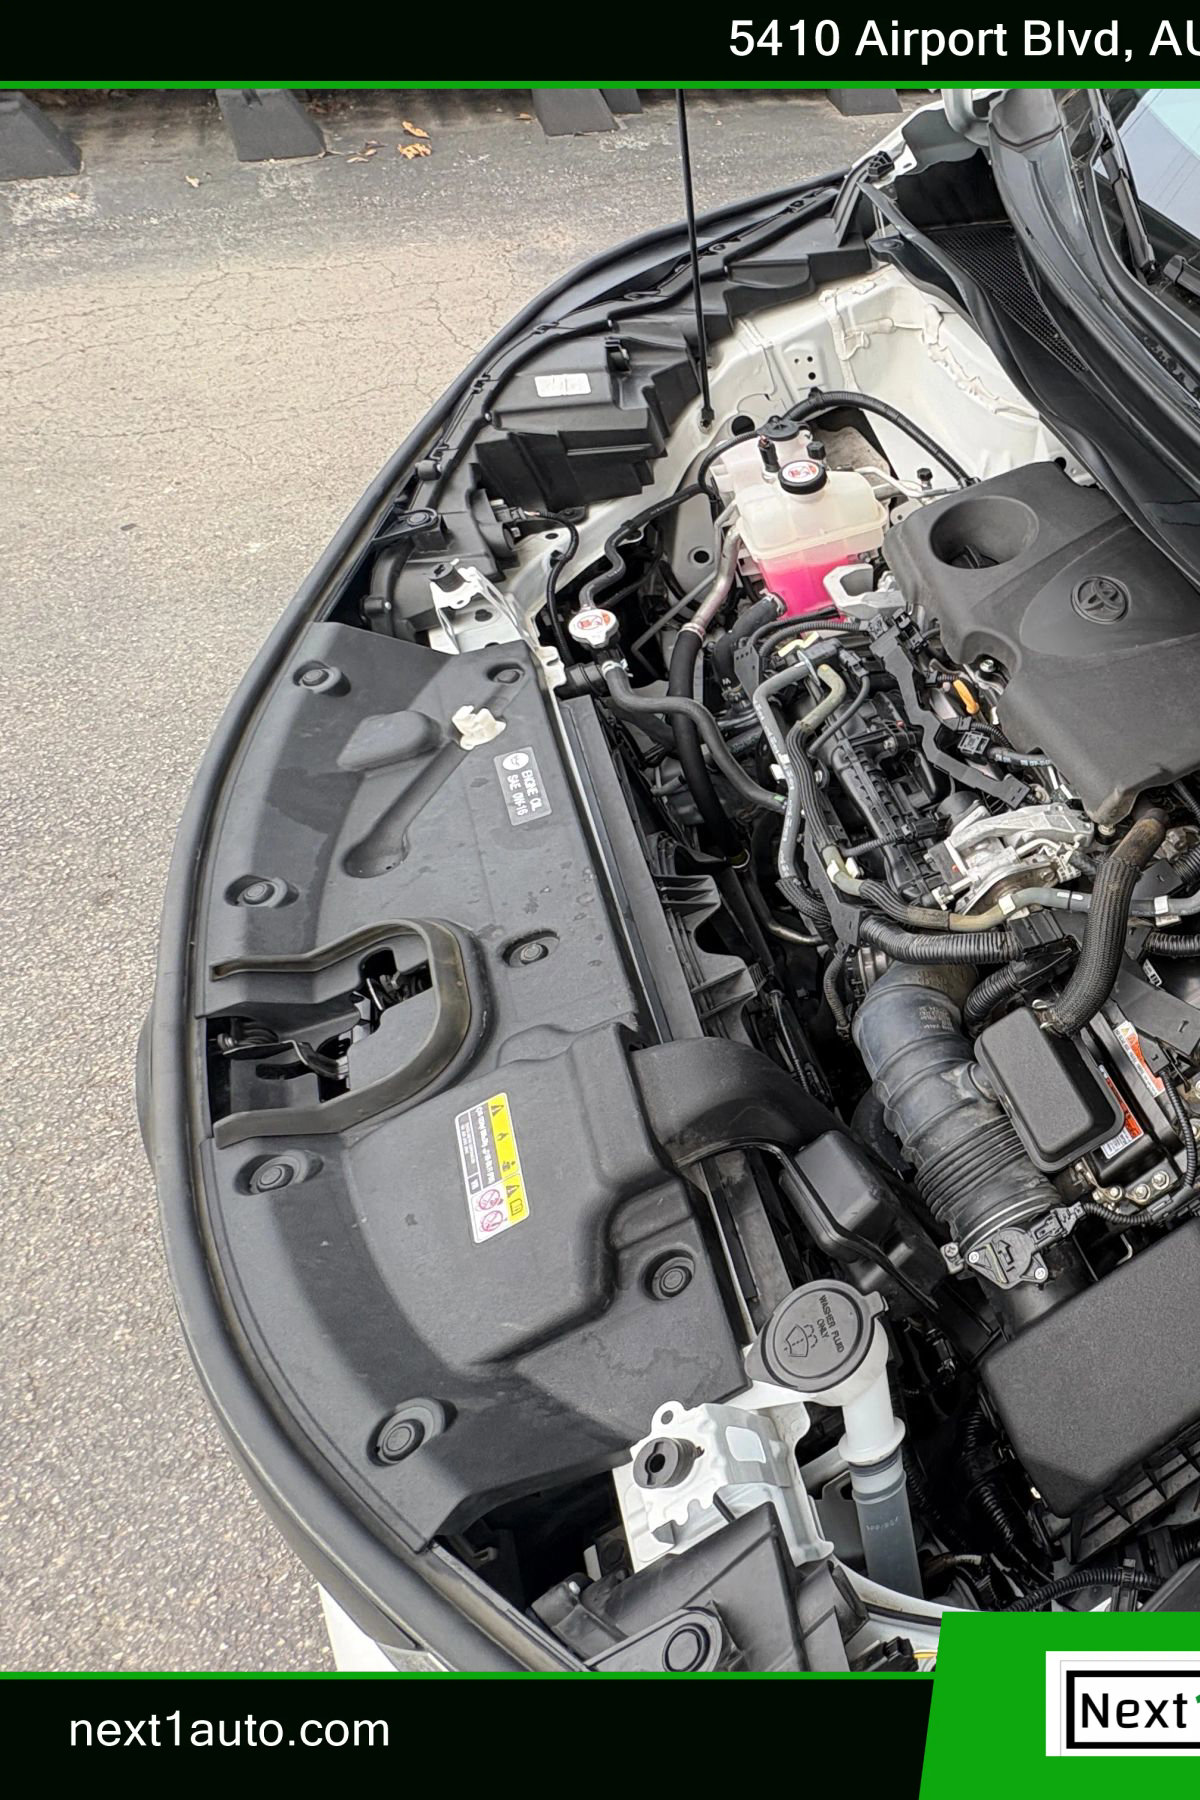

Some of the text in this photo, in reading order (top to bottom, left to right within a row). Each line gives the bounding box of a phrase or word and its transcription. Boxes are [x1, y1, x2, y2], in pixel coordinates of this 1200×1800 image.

[816, 1318, 830, 1338] ONLY
[819, 1294, 845, 1353] WASHER FLUID
